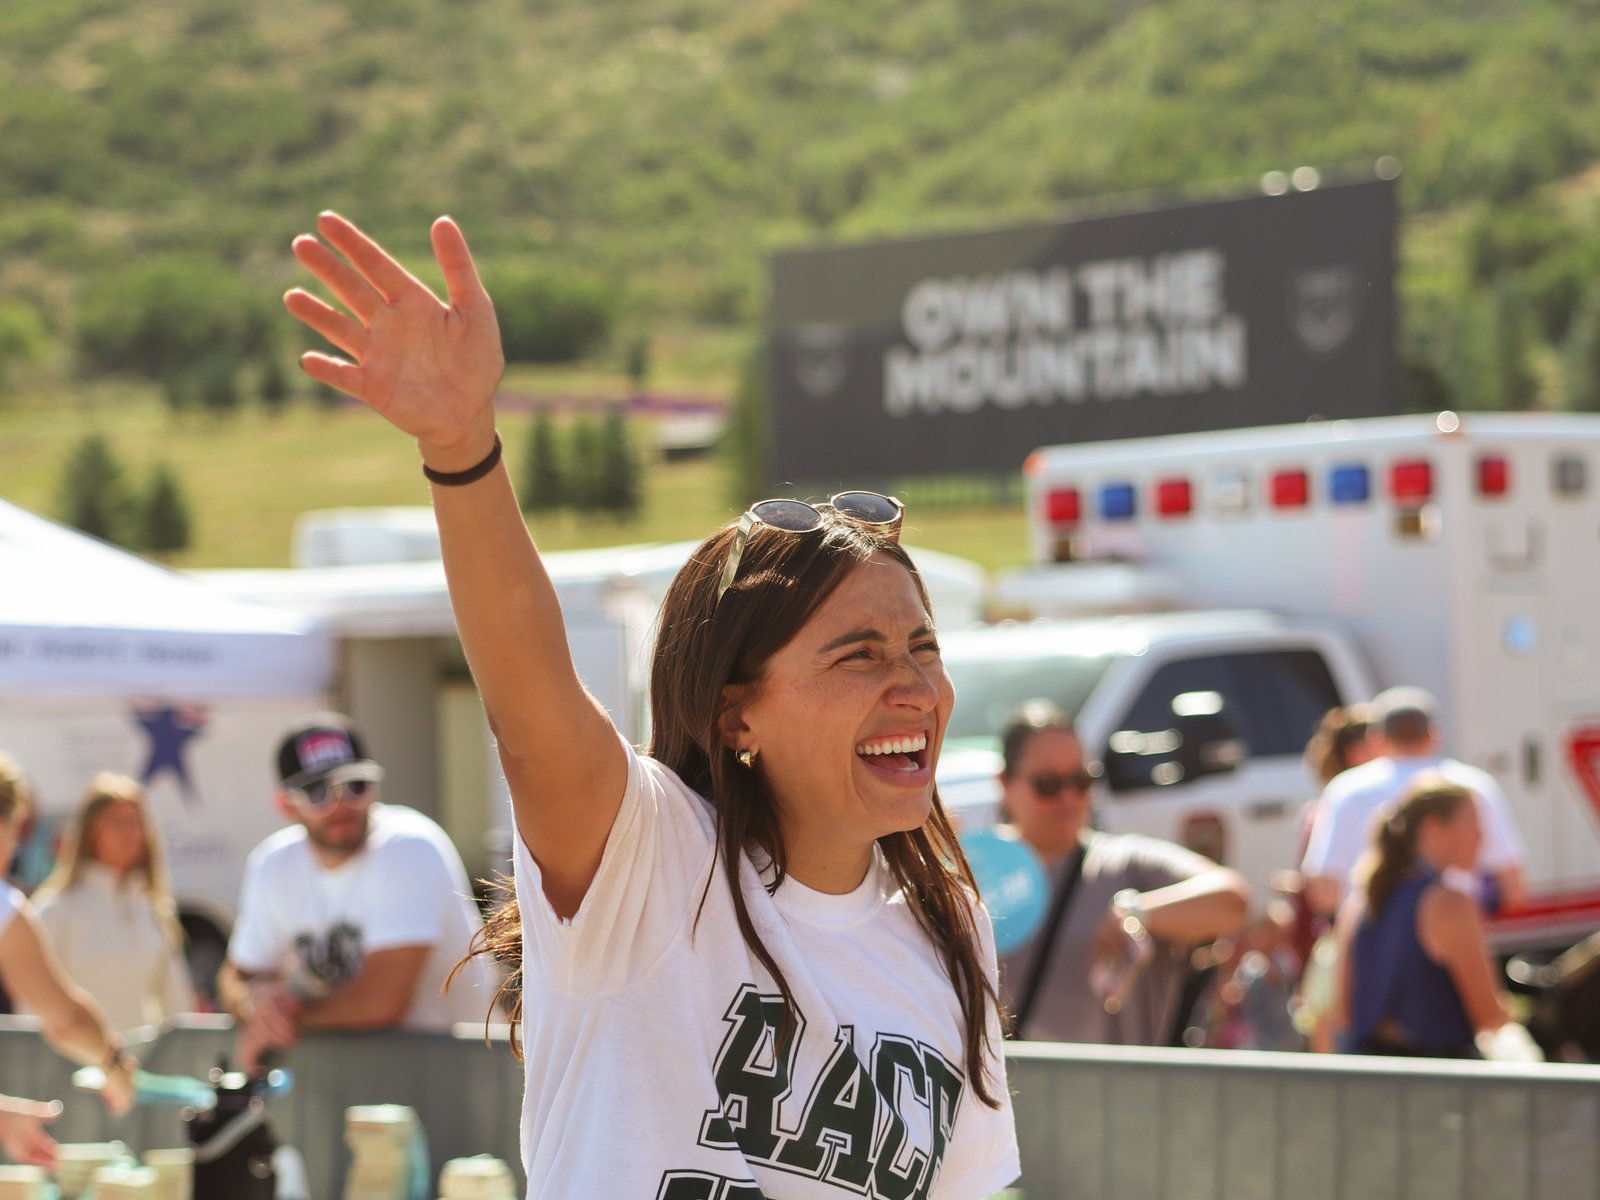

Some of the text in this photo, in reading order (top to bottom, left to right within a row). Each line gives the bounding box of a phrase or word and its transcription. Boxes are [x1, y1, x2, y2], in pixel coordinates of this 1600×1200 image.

[904, 248, 1225, 350] OWN THE
[884, 316, 1247, 415] MOUNTAIN
